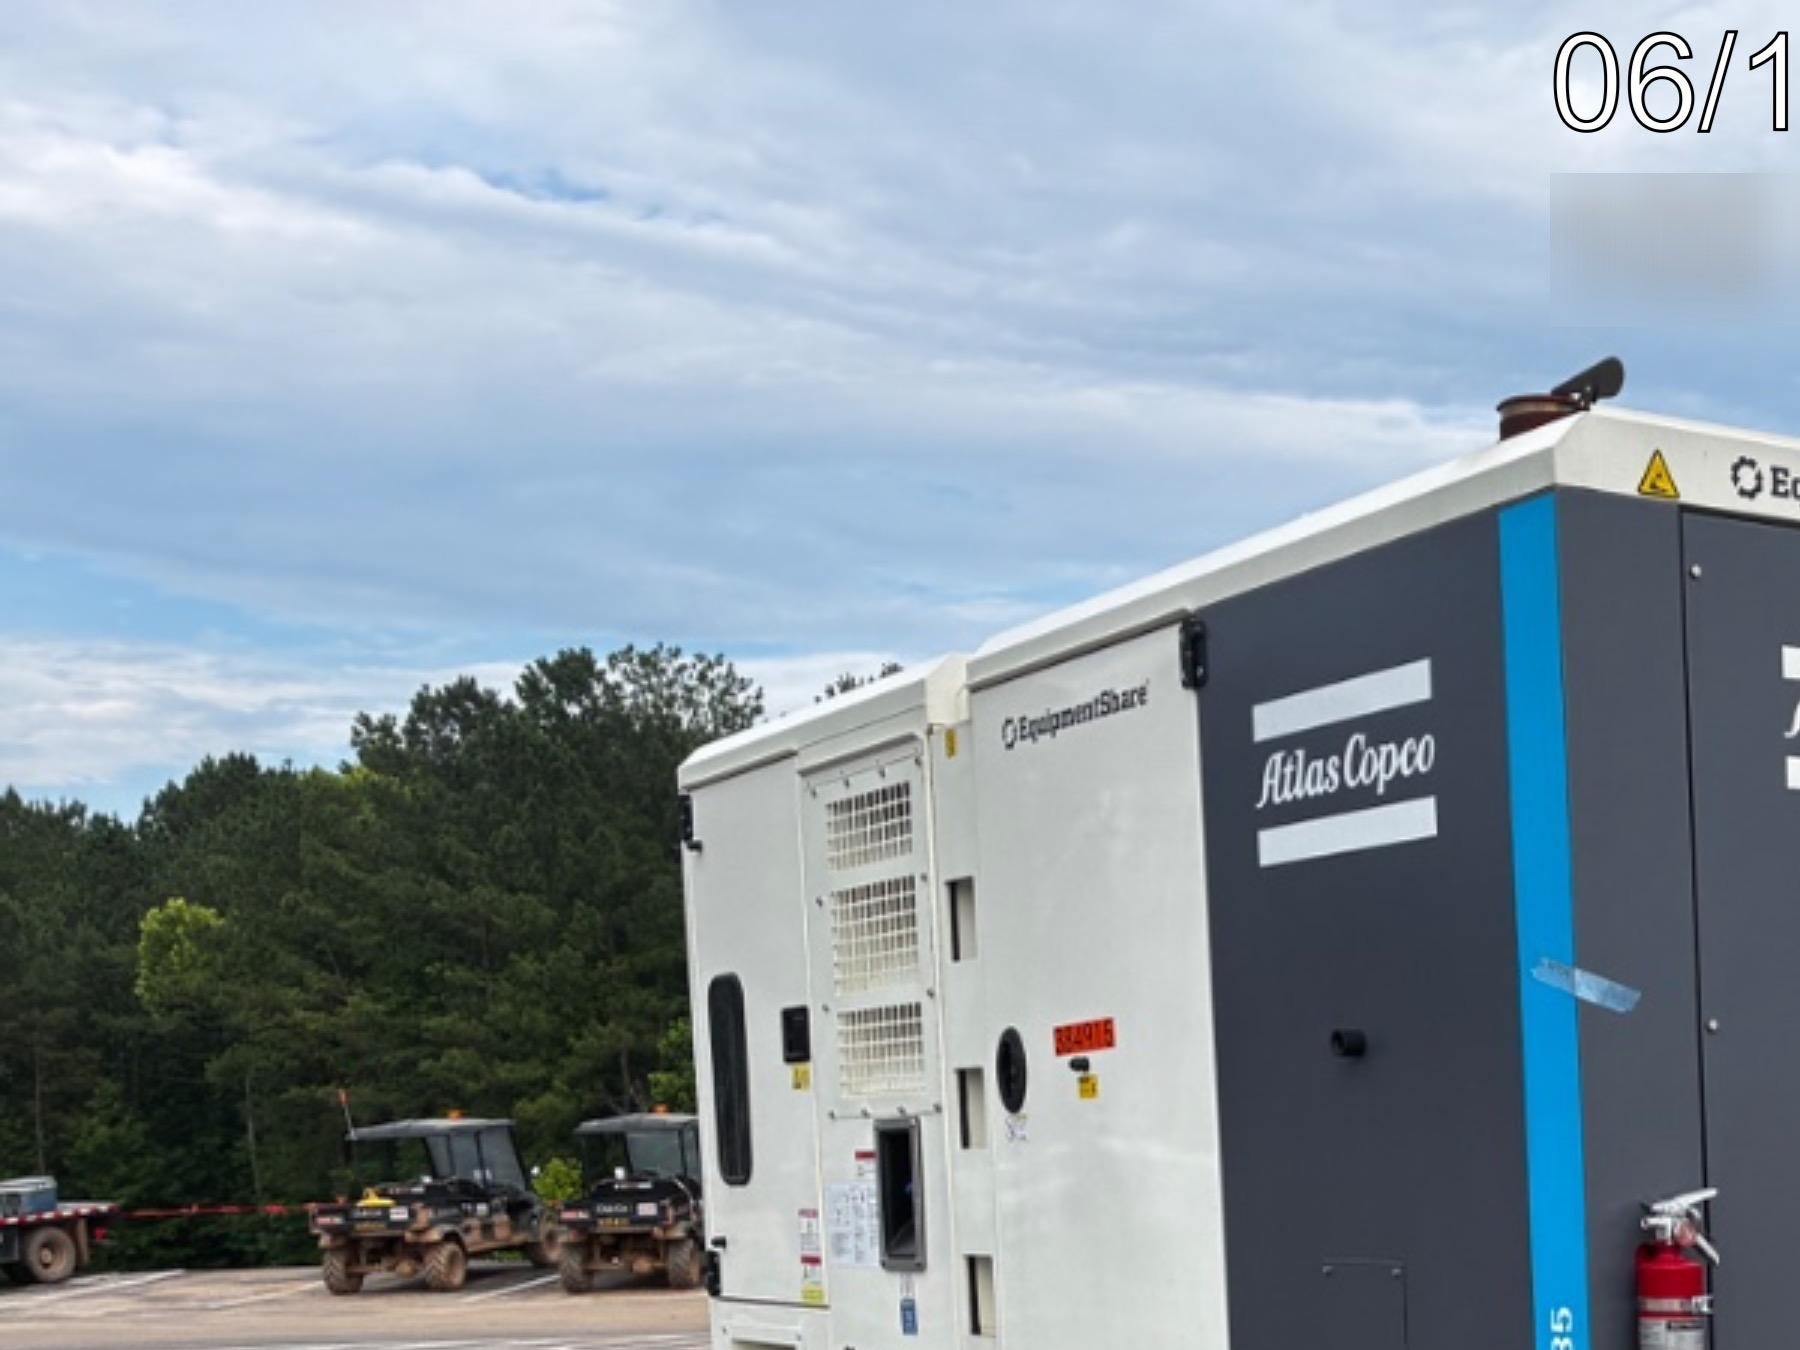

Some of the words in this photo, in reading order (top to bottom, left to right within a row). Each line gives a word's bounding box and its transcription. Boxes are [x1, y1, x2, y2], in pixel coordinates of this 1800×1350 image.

[1018, 684, 1149, 744] EquipmentShare
[1255, 747, 1341, 809] Atlas
[1342, 732, 1436, 797] Copco
